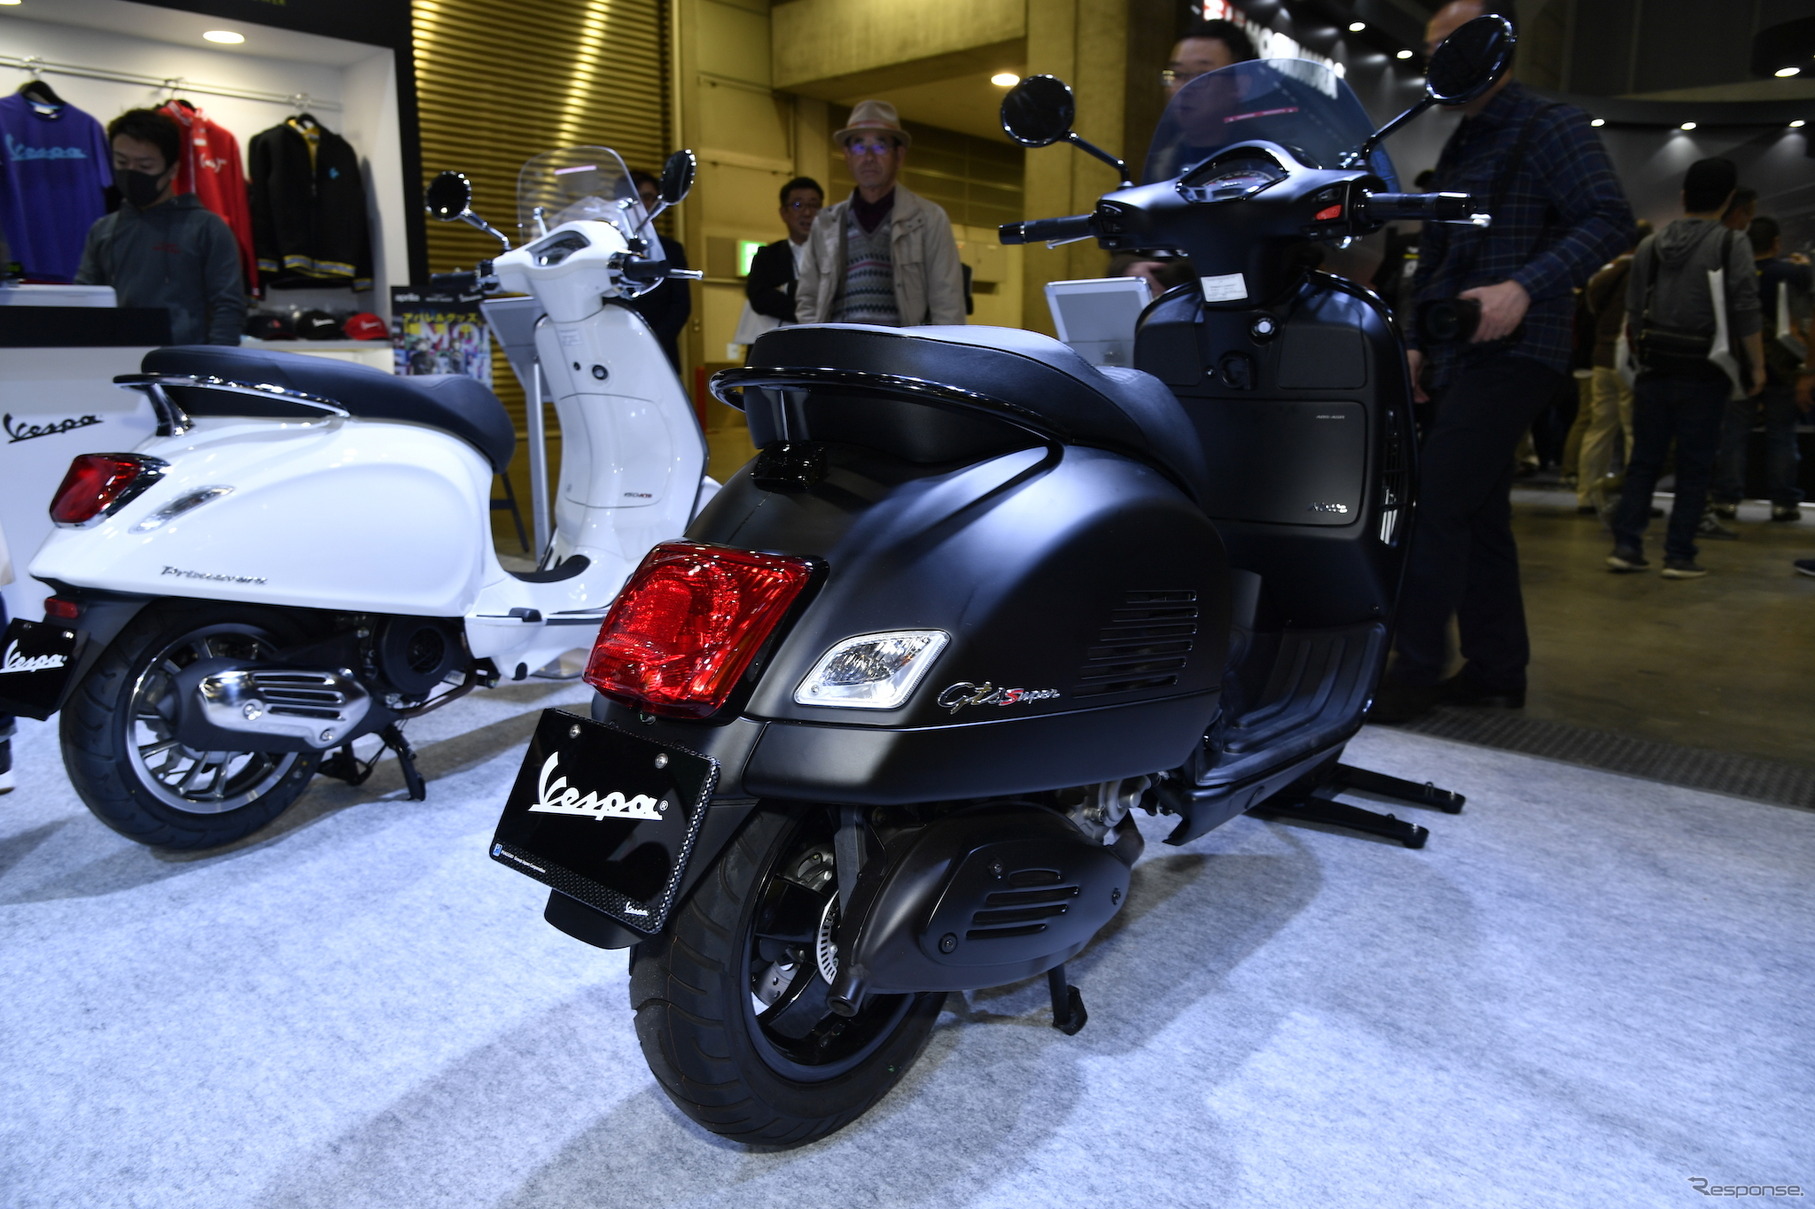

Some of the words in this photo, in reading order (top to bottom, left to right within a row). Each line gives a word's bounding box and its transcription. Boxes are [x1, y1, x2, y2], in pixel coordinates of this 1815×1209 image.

[5, 133, 87, 161] Vespa
[3, 412, 104, 444] Vespa
[0, 638, 65, 672] Vespa
[528, 751, 663, 821] Vespa
[624, 901, 648, 916] Vespa
